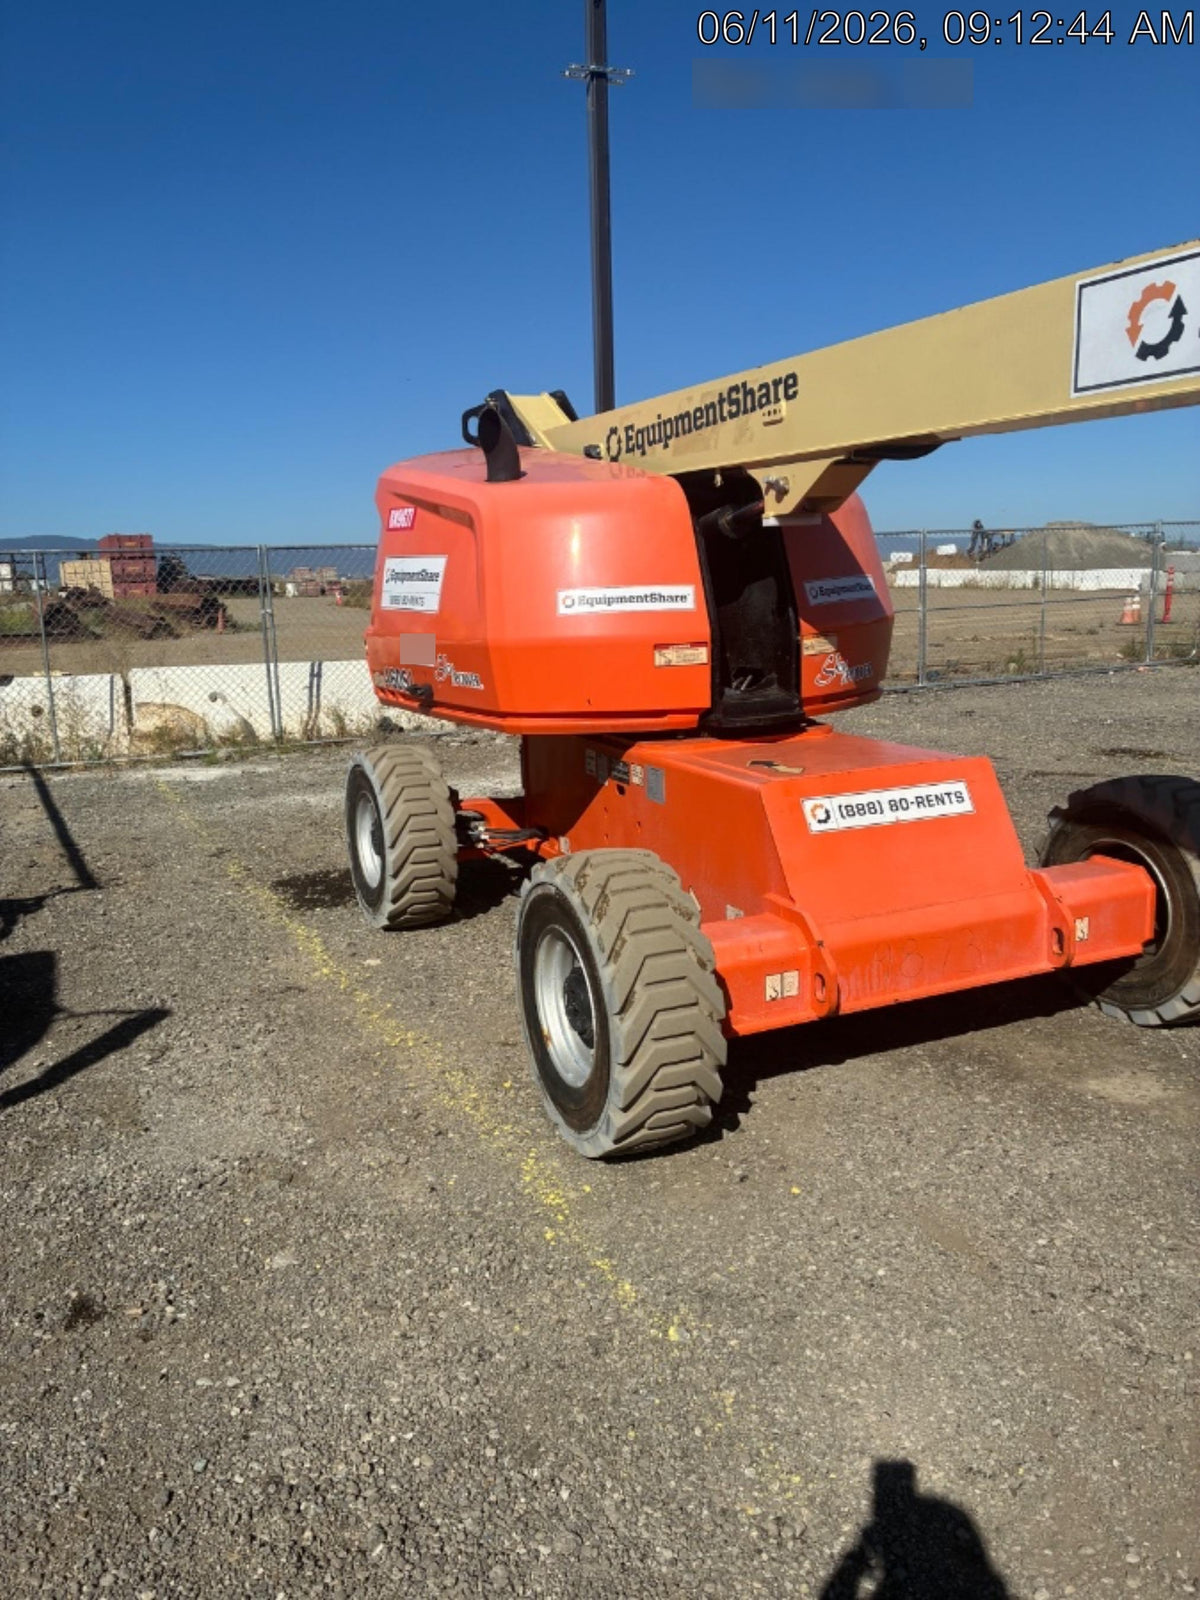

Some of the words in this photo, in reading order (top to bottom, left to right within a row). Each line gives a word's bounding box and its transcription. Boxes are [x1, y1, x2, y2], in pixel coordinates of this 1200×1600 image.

[623, 371, 799, 457] EquipmentShare
[577, 592, 688, 608] EquipmentShare
[838, 800, 884, 819] (888)
[888, 791, 965, 812] 80-RENTS
